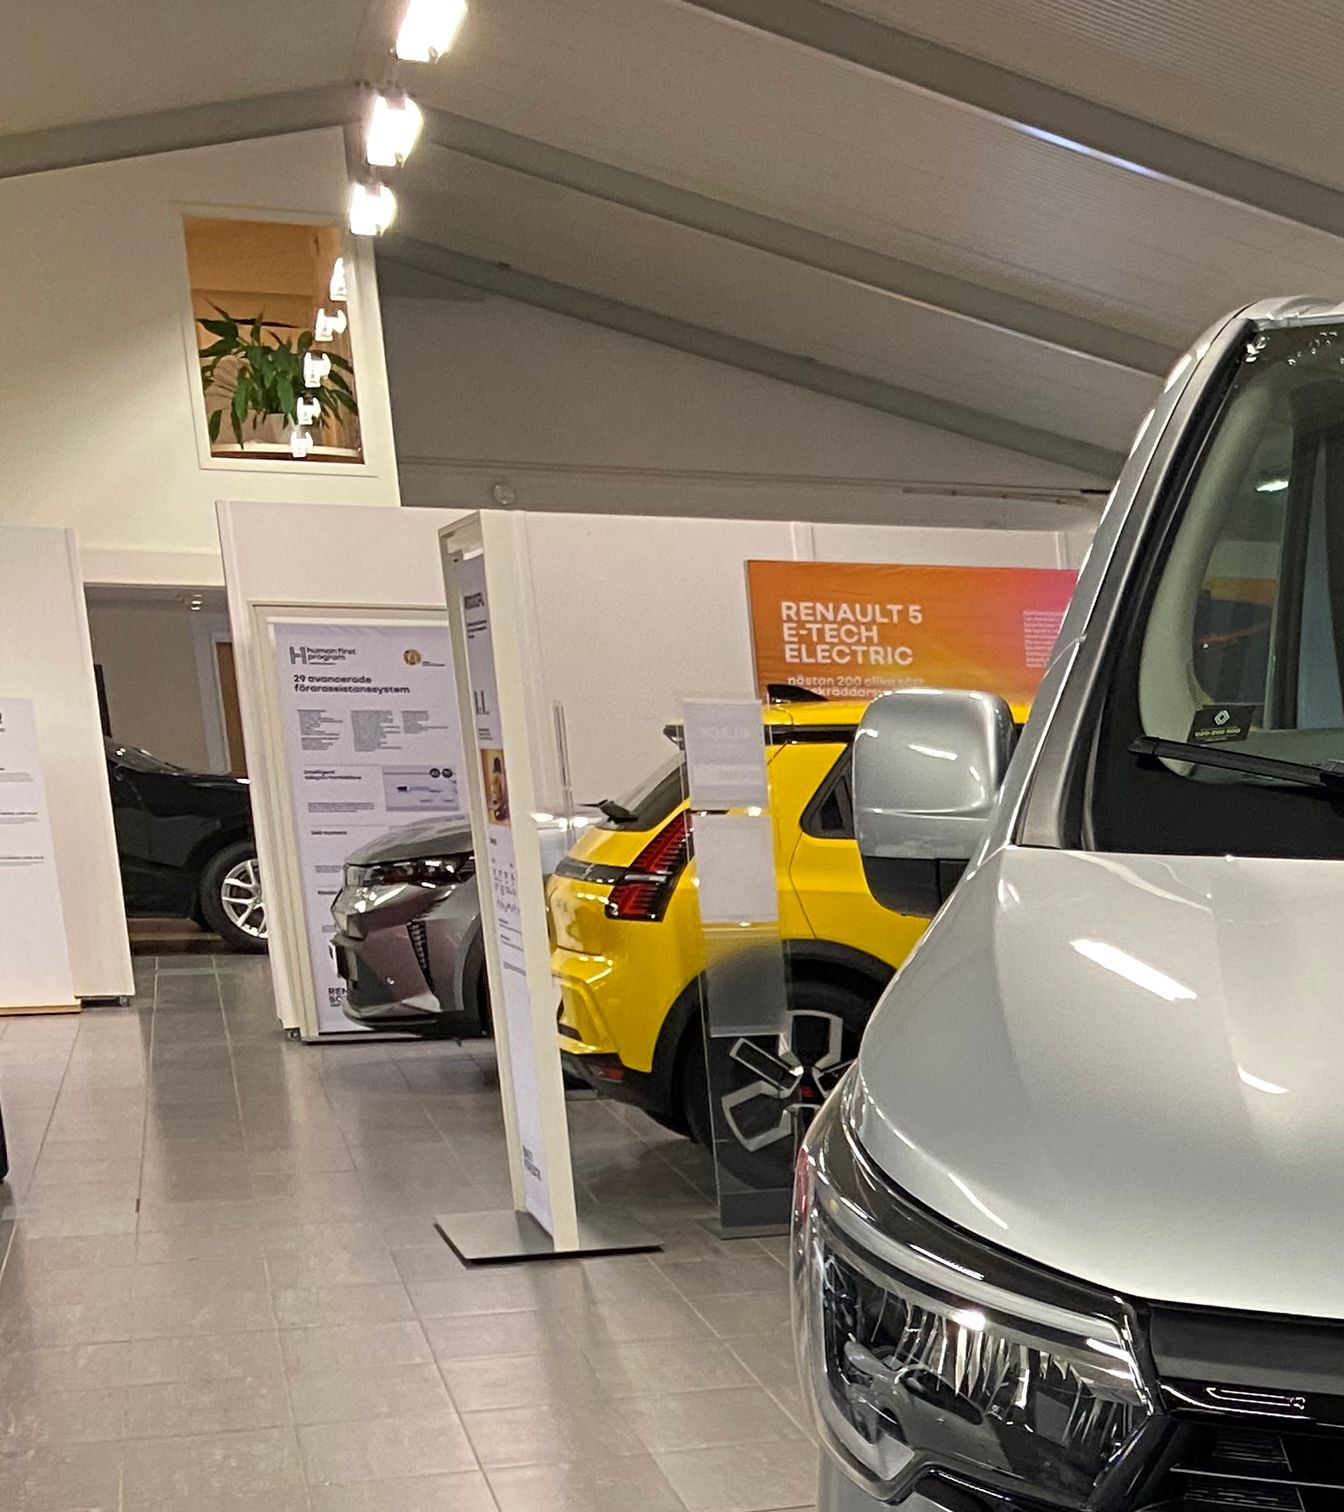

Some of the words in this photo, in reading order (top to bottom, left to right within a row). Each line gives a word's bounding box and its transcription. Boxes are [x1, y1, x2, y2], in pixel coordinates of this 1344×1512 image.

[781, 601, 903, 624] RENAULT
[908, 604, 923, 624] 5
[783, 622, 878, 643] E-TECH
[338, 647, 356, 655] first
[784, 643, 913, 665] ELECTRIC
[293, 674, 306, 683] 29
[307, 675, 372, 684] avancerade
[836, 676, 861, 686] 200
[294, 684, 411, 695] förarassistanssystem
